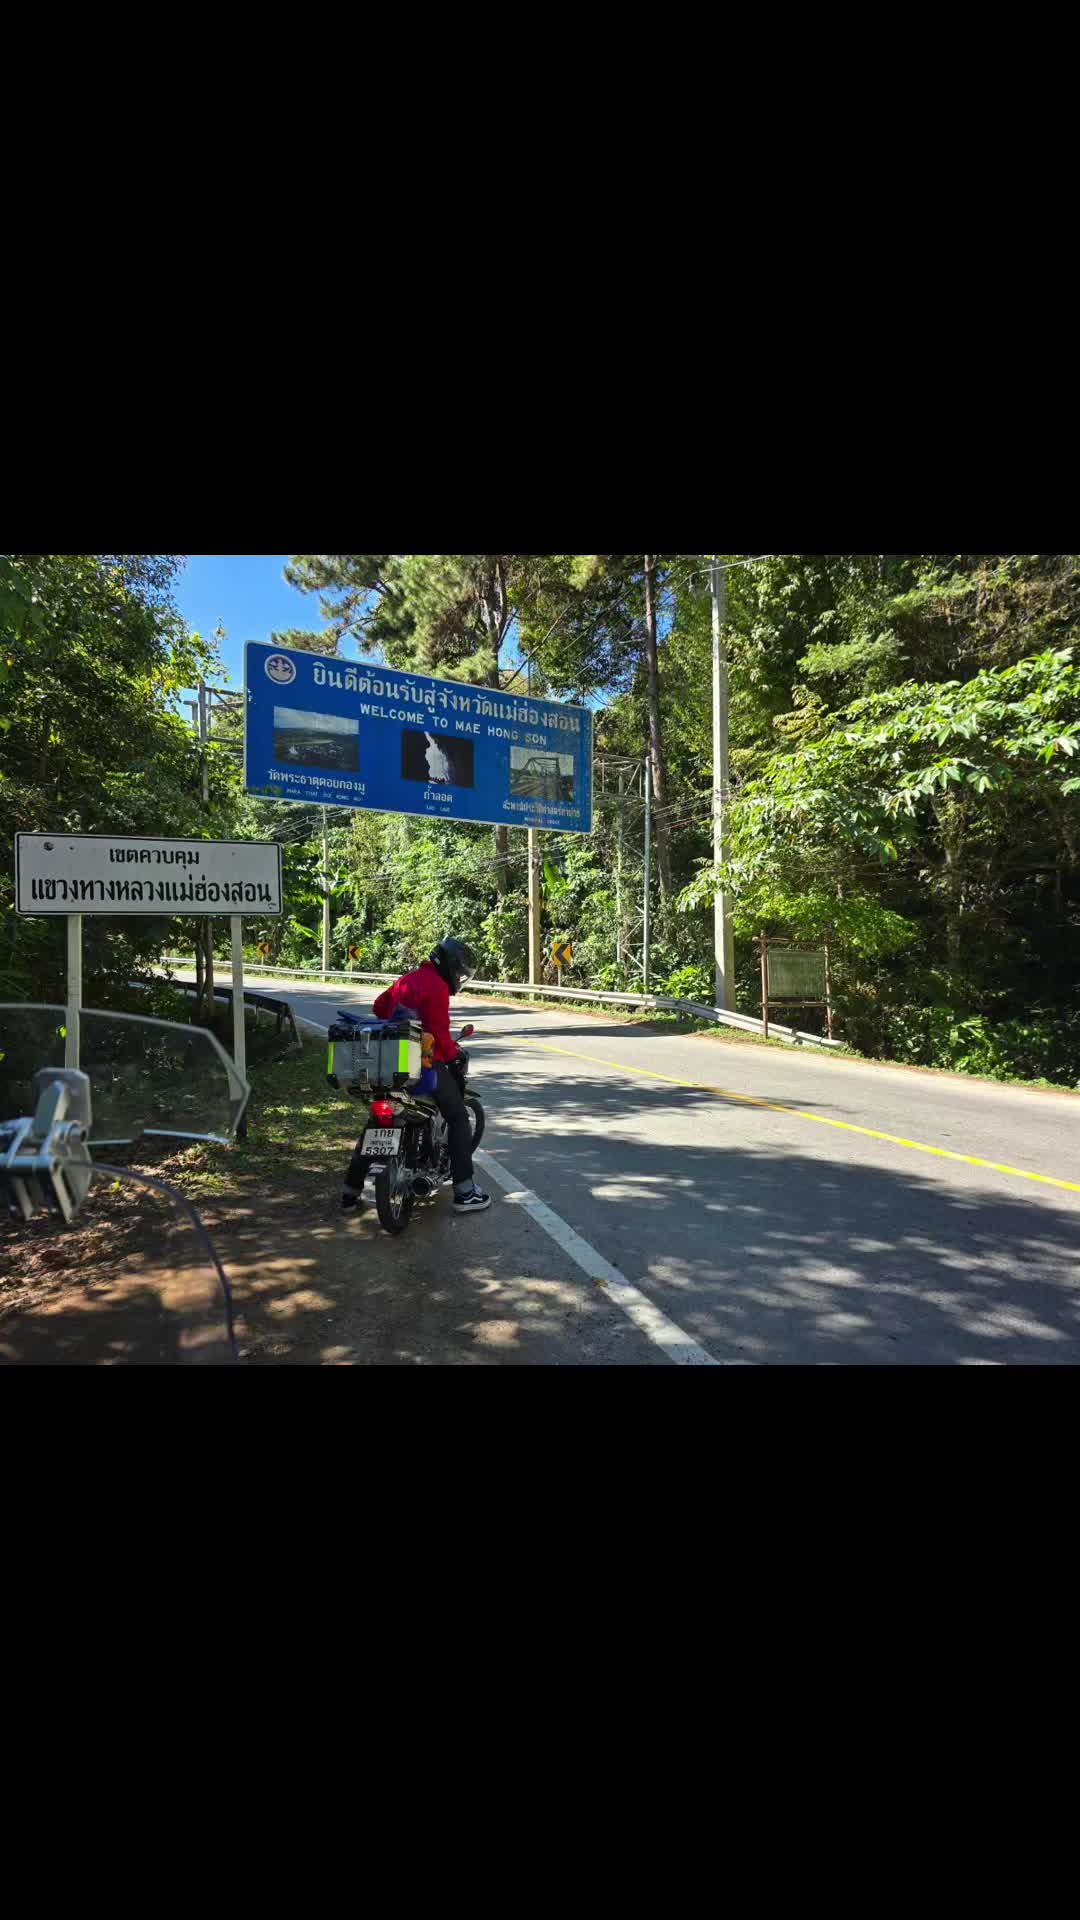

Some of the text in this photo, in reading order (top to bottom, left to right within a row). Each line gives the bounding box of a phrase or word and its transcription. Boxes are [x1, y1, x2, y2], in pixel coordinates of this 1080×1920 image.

[312, 661, 581, 734] ยินดีต้อนรับสู่จังหวัดแม่ฮ่องสอน
[360, 703, 547, 746] WELCOME TO MAE HONG SON
[109, 848, 200, 870] เขตควบคุม
[31, 874, 273, 903] แขวงทางหลวงแม่ฮ่องสอน
[365, 1146, 395, 1156] 5307
